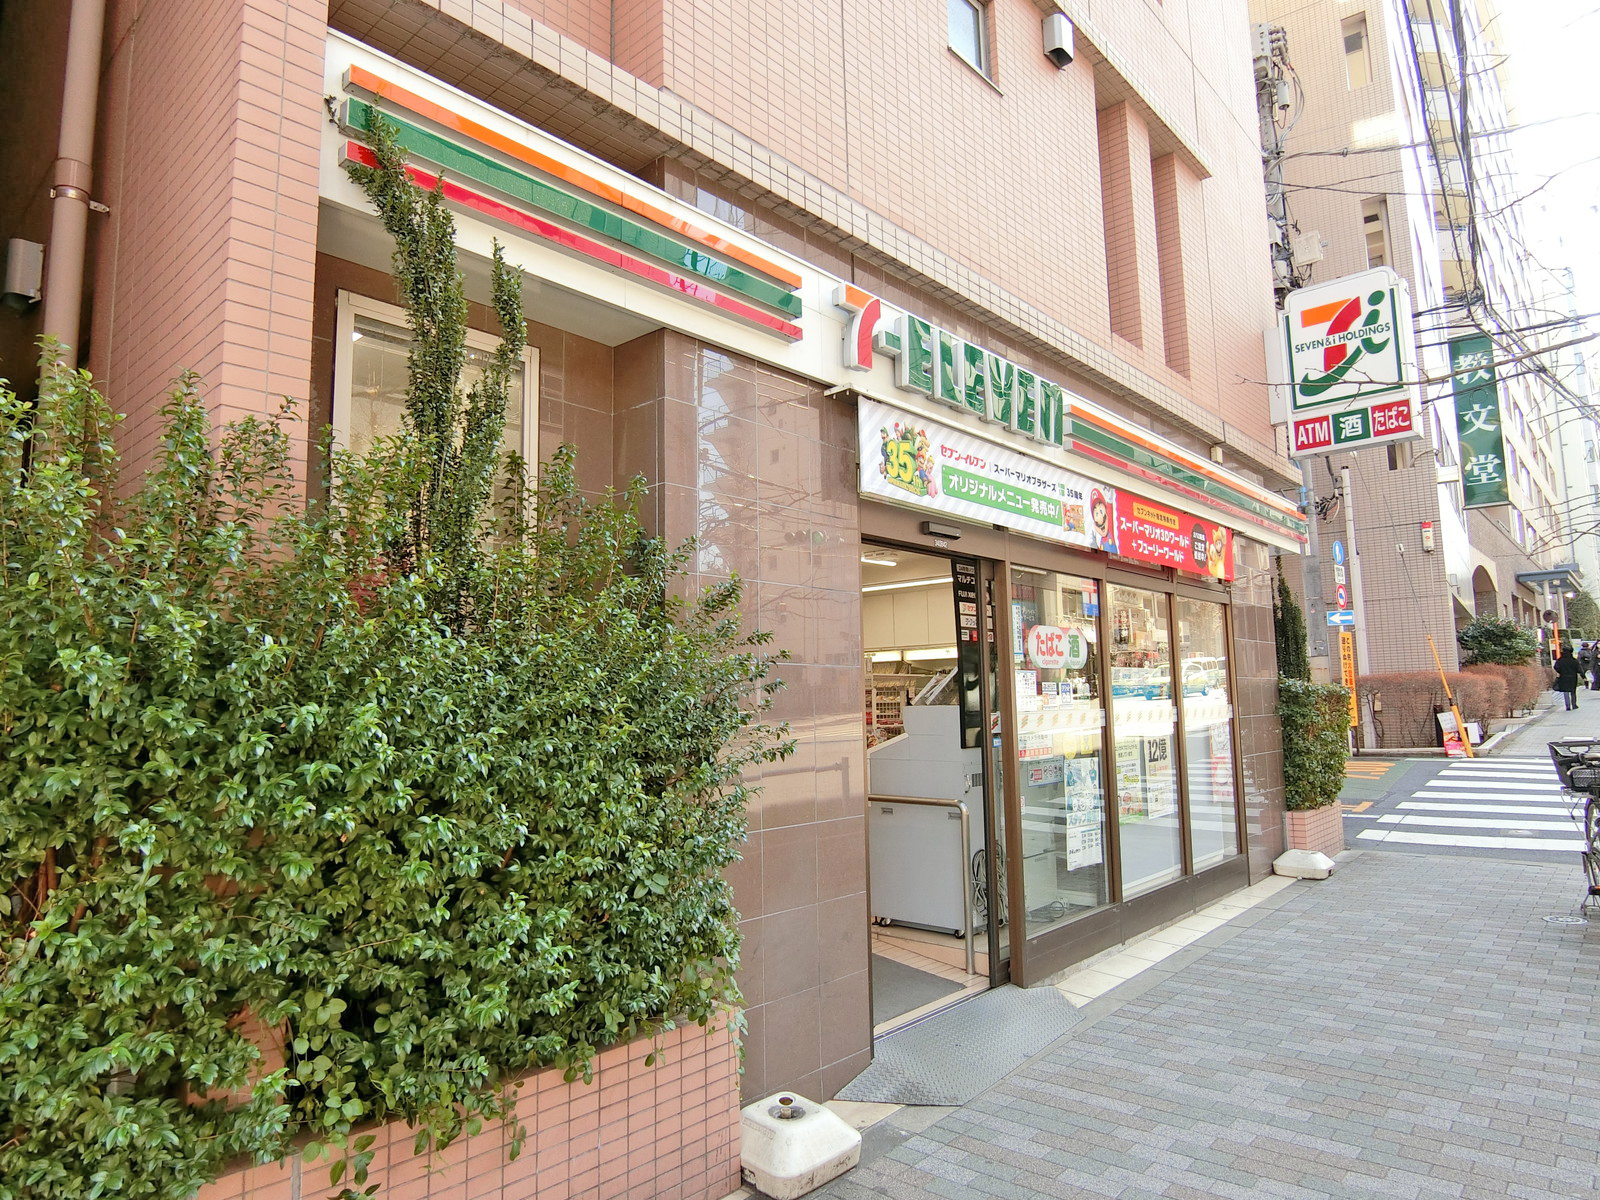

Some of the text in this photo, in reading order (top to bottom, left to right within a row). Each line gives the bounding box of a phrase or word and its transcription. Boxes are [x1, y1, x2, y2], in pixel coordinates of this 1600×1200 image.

[1338, 322, 1391, 342] HOLDINGS
[1339, 414, 1363, 440] 酒
[1373, 405, 1410, 432] たばこ
[1297, 420, 1329, 446] ATM
[1120, 517, 1190, 549] スーパーマリオ3Dワールド
[1036, 631, 1080, 659] たばこ 酒
[1148, 737, 1168, 763] 12億
